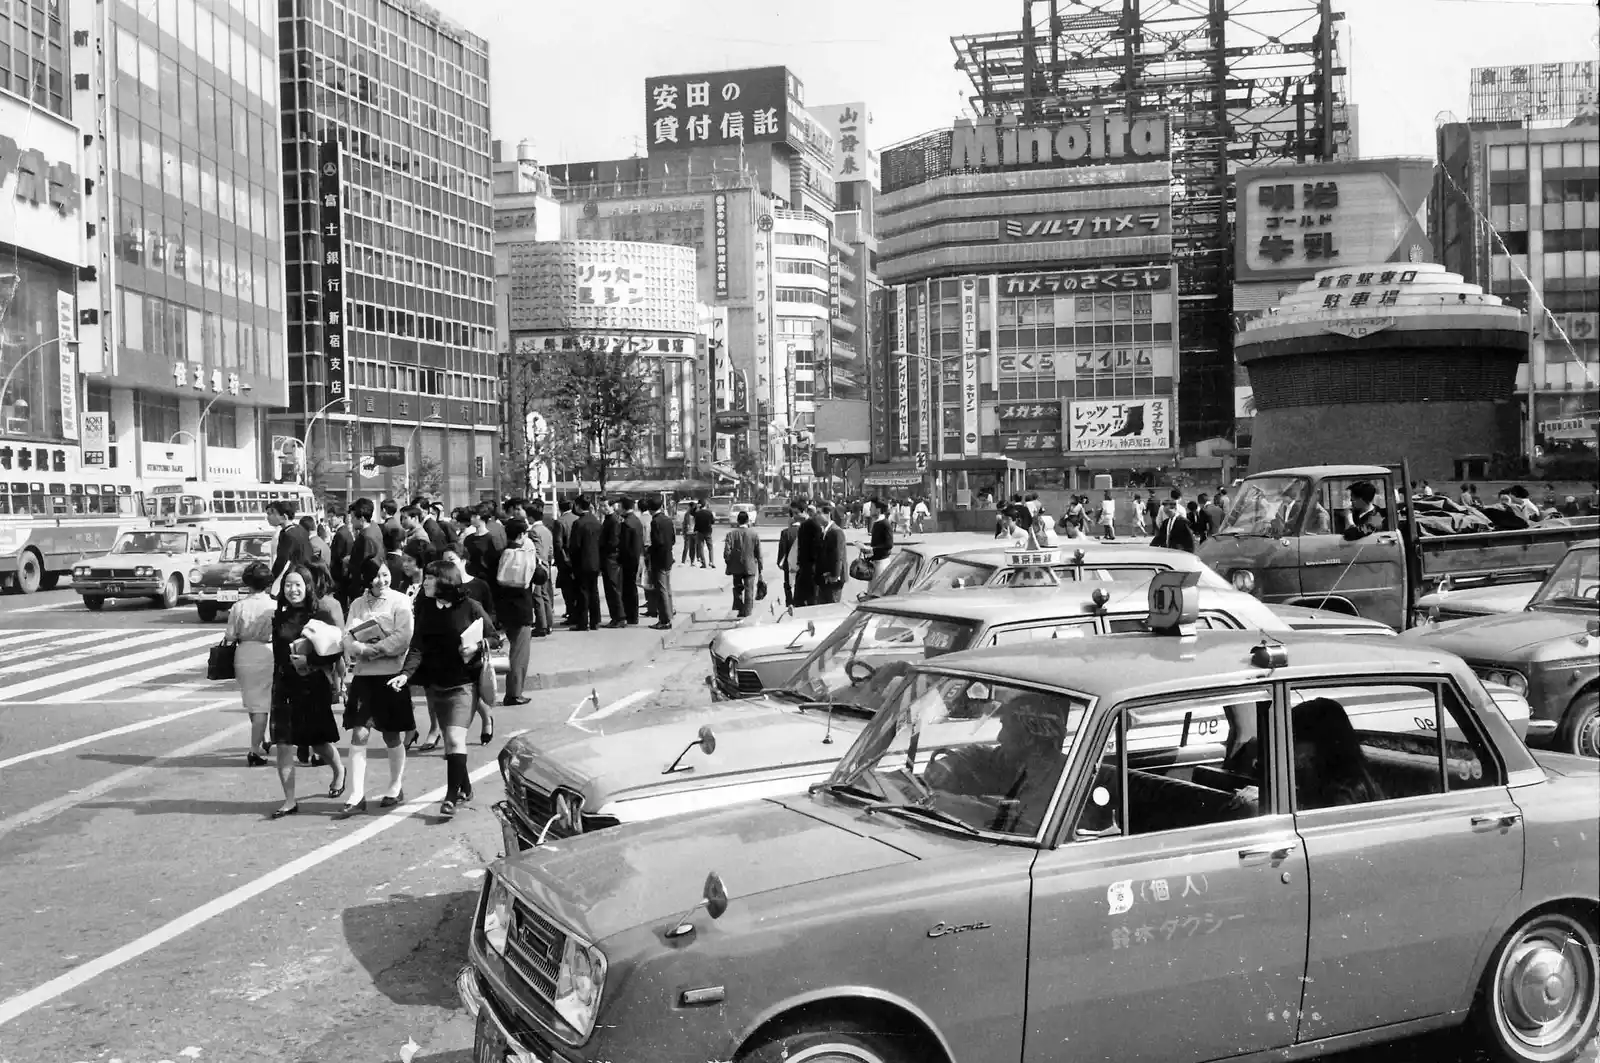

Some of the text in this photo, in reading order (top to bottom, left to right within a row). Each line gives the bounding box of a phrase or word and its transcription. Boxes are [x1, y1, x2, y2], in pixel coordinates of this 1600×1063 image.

[653, 81, 741, 111] 安田の
[654, 106, 779, 145] 貸付信託
[951, 106, 1167, 169] Minolta
[1006, 212, 1160, 237] ミノルタカメラ
[1266, 213, 1332, 229] ゴールド
[1322, 289, 1401, 309] 駐車場
[999, 349, 1151, 372] さくら フィルム
[1075, 405, 1109, 421] レッツ
